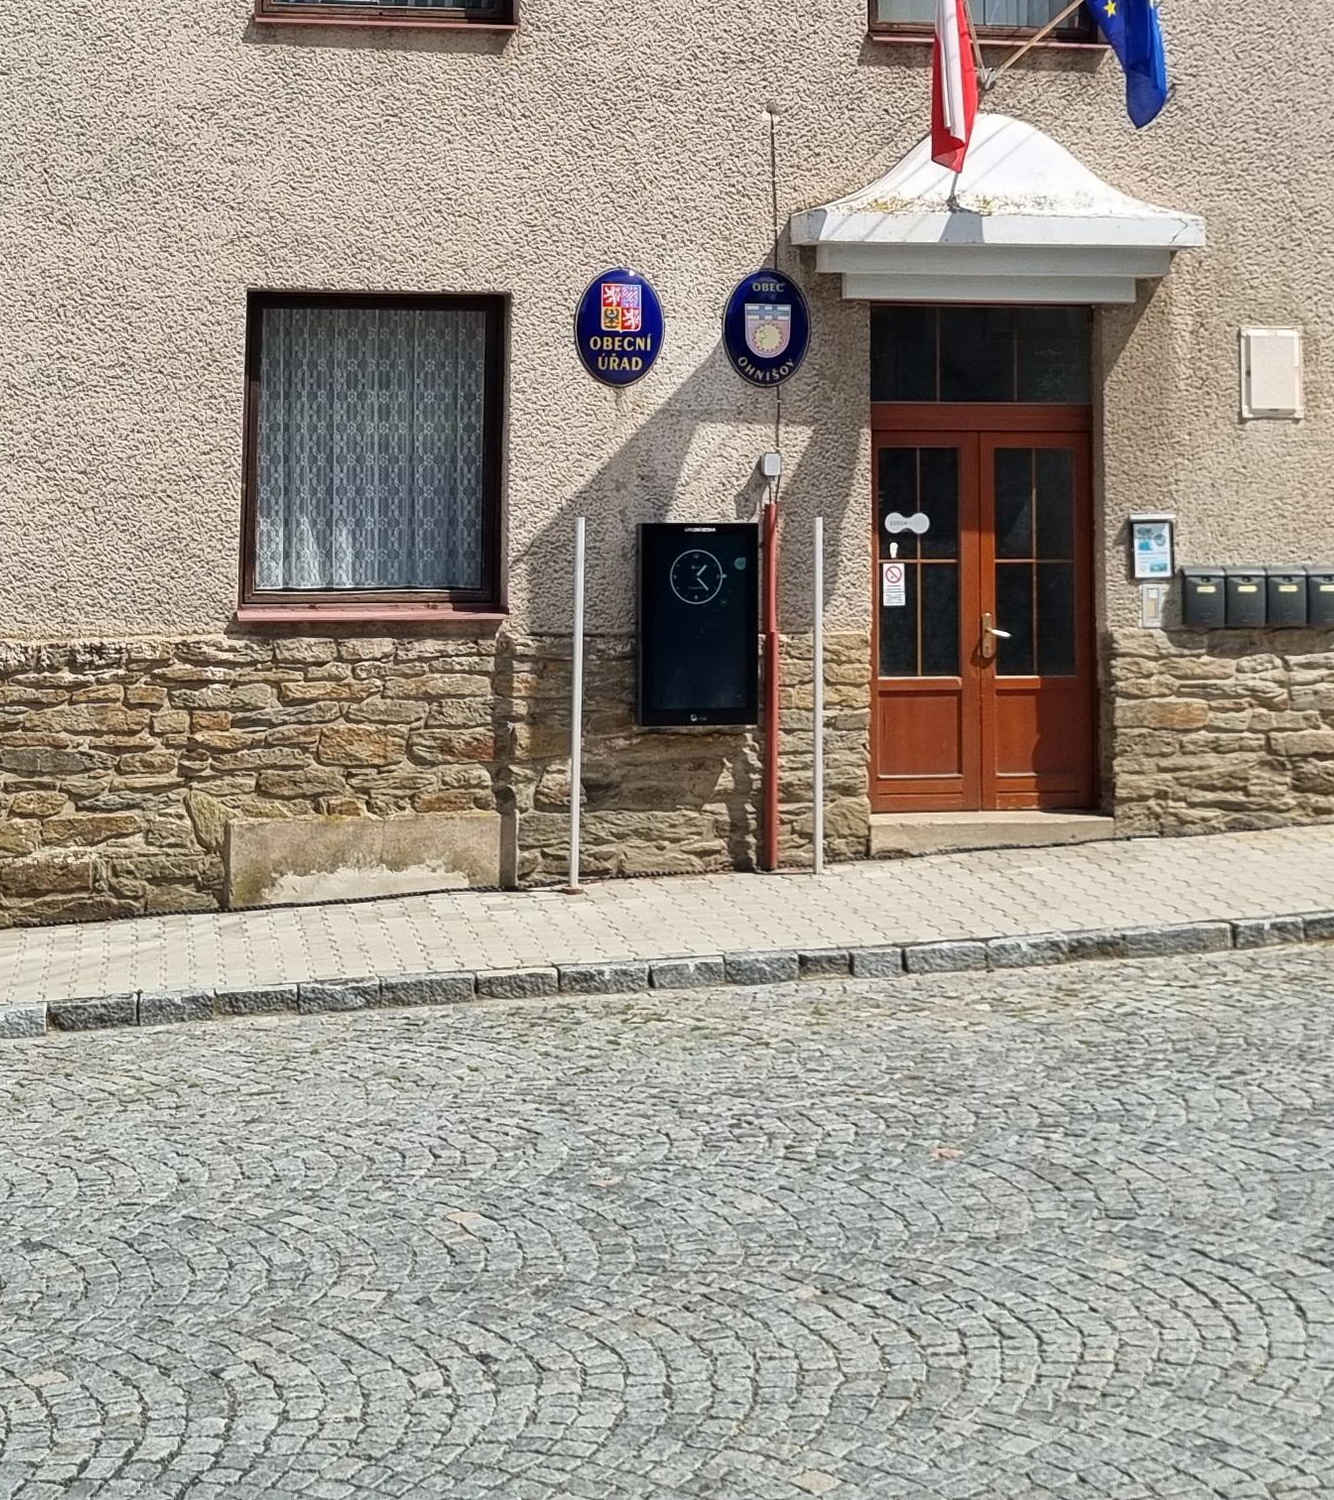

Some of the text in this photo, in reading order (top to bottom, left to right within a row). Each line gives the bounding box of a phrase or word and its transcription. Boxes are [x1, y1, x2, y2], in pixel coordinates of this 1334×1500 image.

[752, 281, 785, 293] OBEC
[589, 333, 652, 351] OBECNÍ
[597, 353, 643, 372] ÚŘAD
[737, 356, 795, 381] OHNIŠOV
